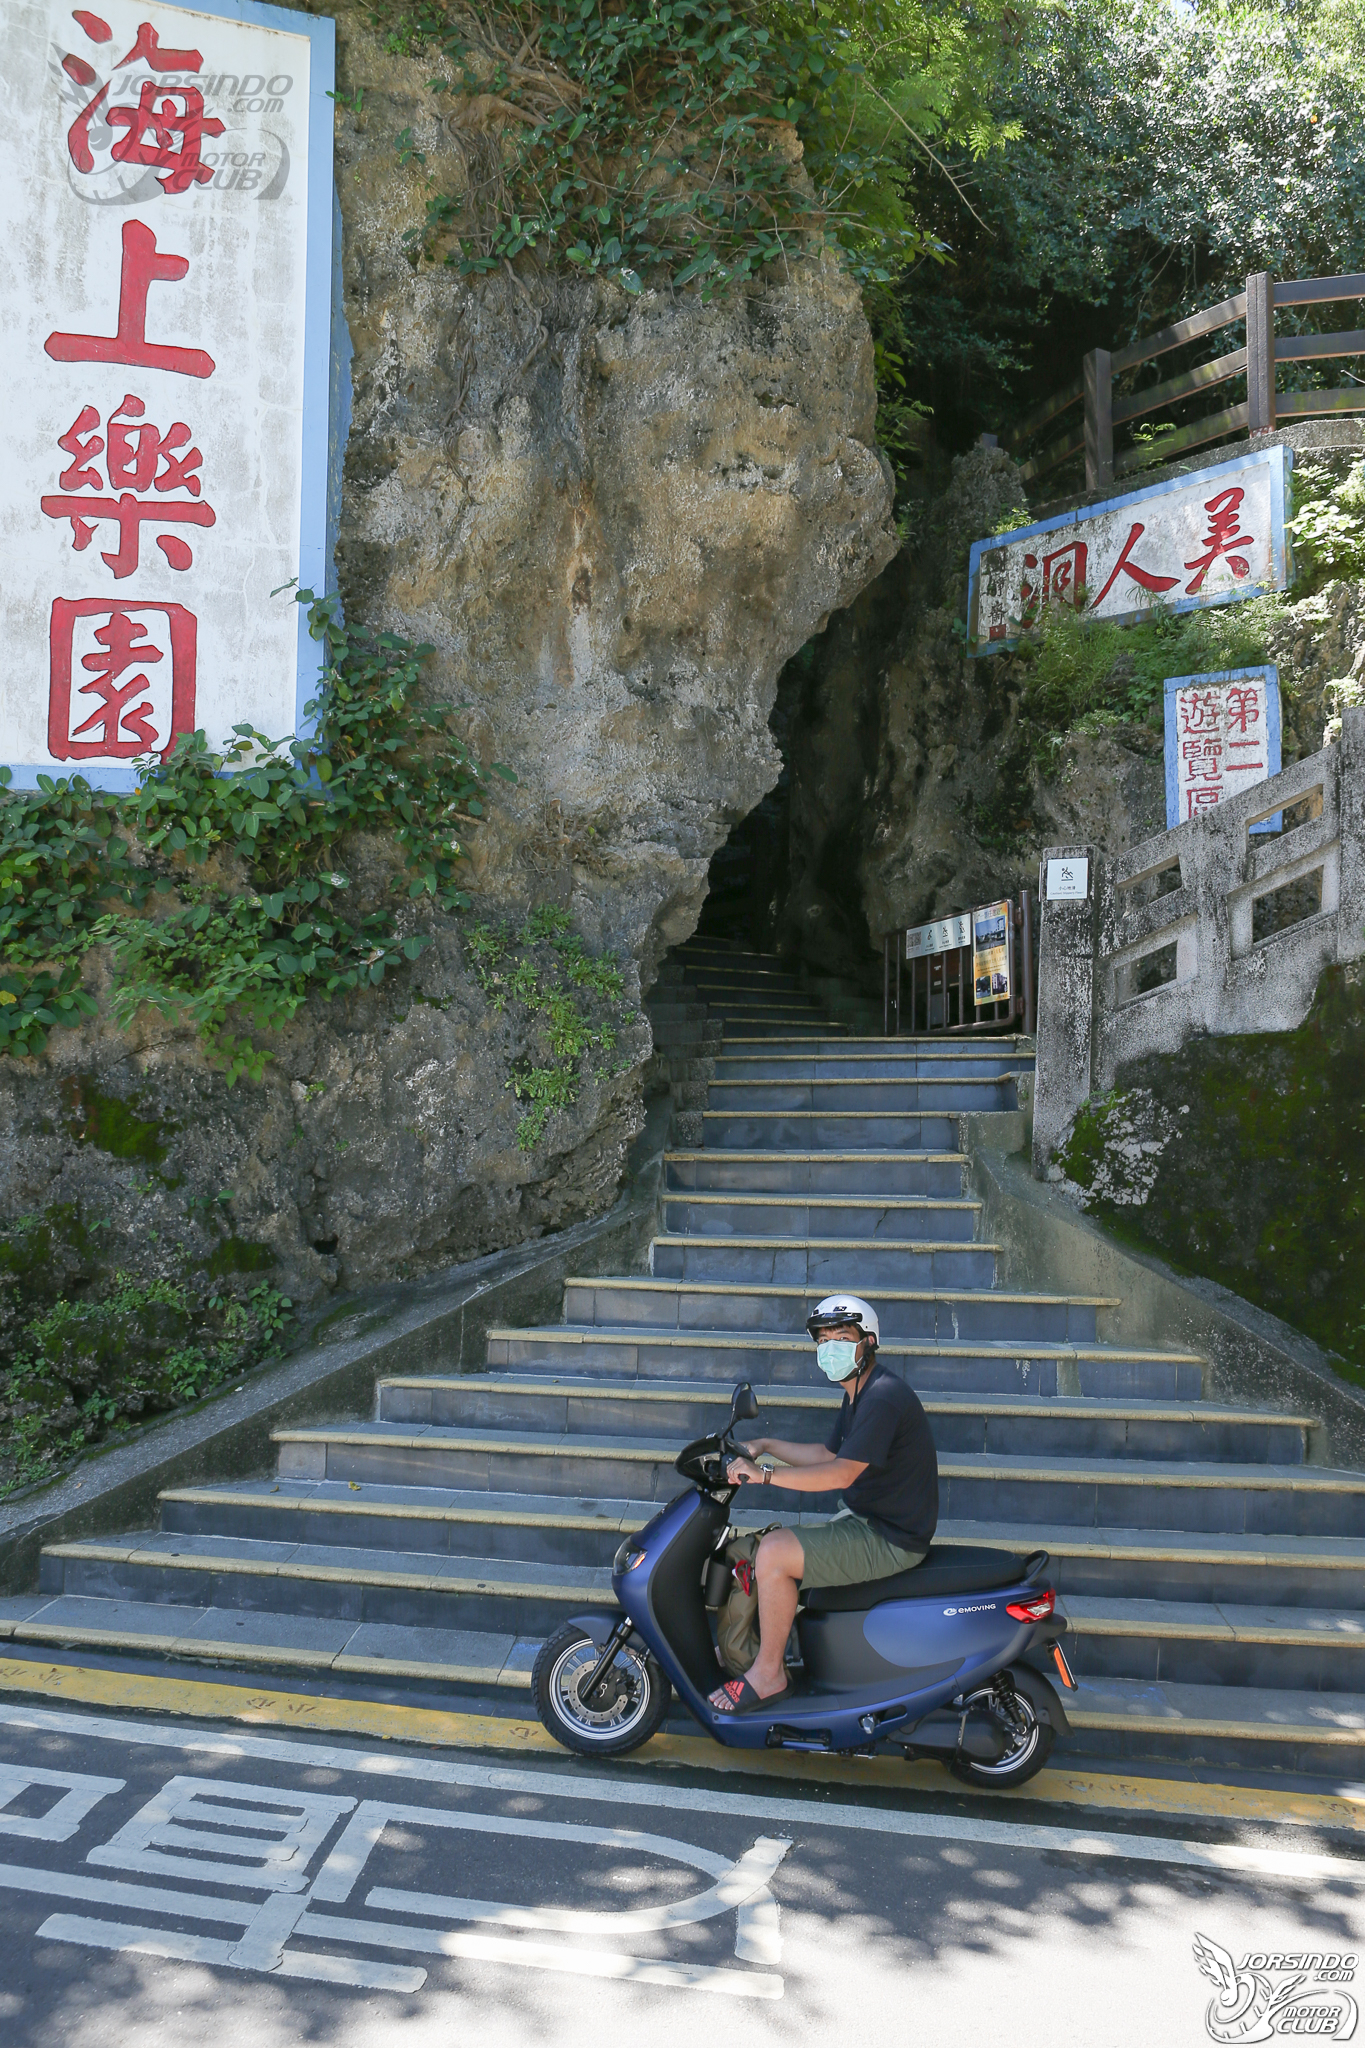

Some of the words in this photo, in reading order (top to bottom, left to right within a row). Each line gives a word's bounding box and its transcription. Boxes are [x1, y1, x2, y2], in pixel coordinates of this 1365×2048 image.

[42, 10, 226, 765] 海上樂園
[1020, 487, 1254, 629] 美人洞
[1226, 688, 1263, 771] 第二
